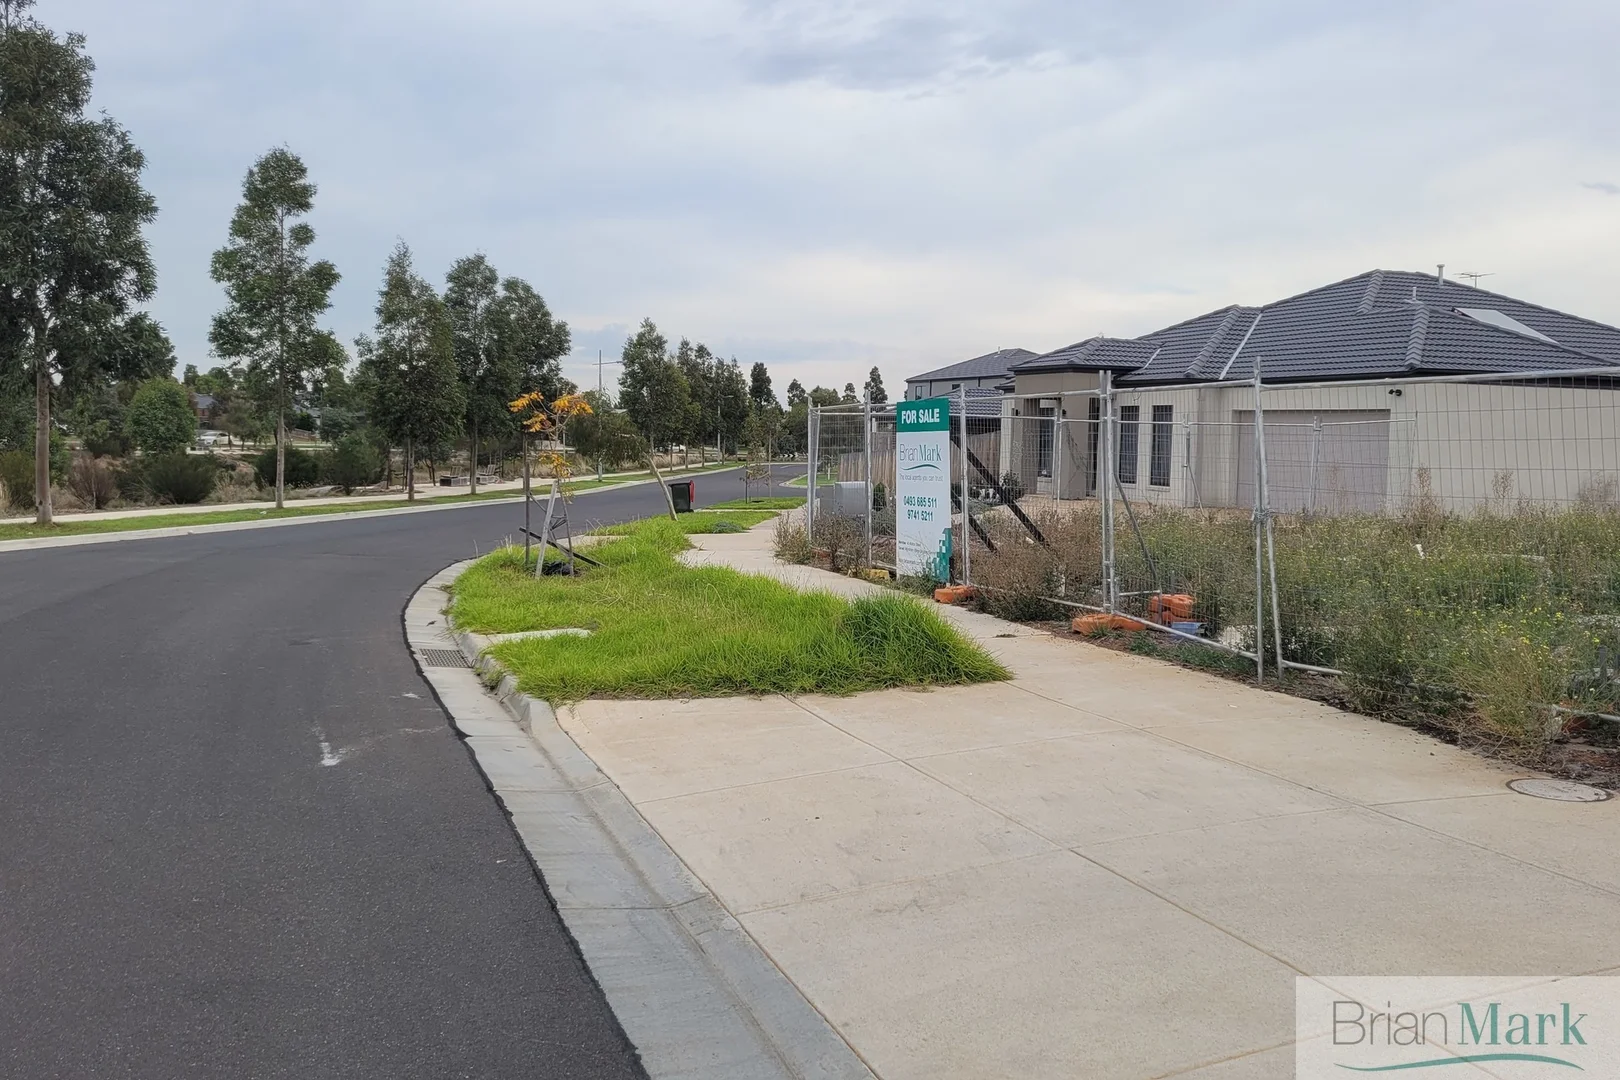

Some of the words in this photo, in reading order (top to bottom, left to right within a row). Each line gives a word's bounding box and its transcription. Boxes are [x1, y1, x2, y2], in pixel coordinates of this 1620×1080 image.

[901, 410, 917, 424] FOR
[919, 408, 940, 423] SALE
[903, 495, 916, 506] 0493
[927, 497, 937, 508] 511
[907, 509, 920, 520] 9741
[920, 510, 934, 521] 5211
